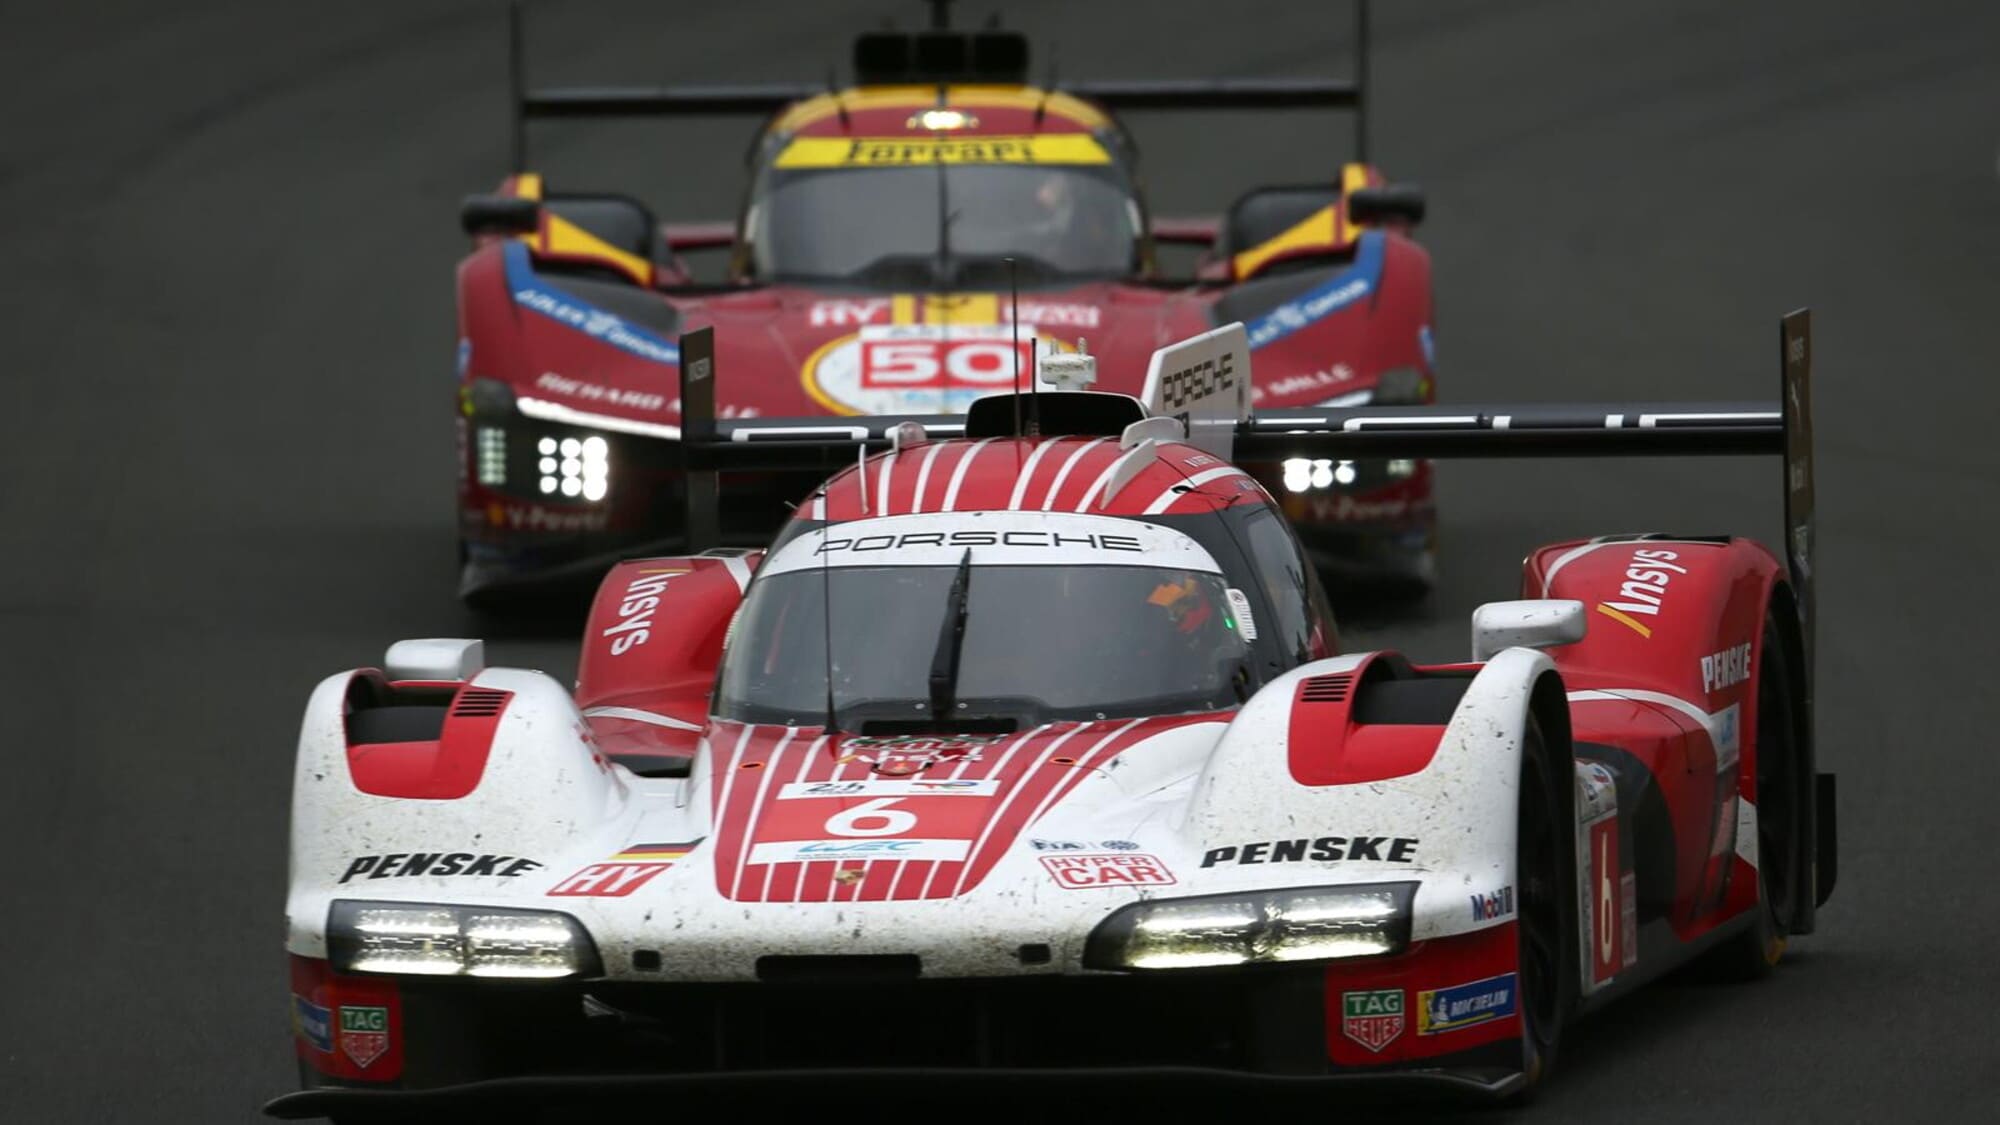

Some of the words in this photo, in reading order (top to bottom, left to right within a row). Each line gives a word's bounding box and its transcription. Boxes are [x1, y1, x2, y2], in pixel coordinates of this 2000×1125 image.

[846, 137, 1041, 165] Ferrari
[870, 344, 1024, 385] 50
[1162, 353, 1233, 411] PORSCHE
[813, 531, 1143, 556] PORSCHE
[1597, 549, 1687, 639] Ansys
[603, 568, 692, 656] Ansys
[1701, 642, 1752, 694] PENSKE
[824, 797, 918, 837] 6
[1049, 856, 1150, 868] HYPER
[1200, 837, 1421, 868] PENSKE
[338, 853, 545, 884] PENSKE
[563, 866, 655, 893] HY
[1060, 866, 1166, 885] CAR
[1600, 831, 1614, 964] 6
[1351, 995, 1398, 1013] TAG
[1450, 989, 1509, 1017] MICHELIN
[343, 1011, 382, 1029] TAG
[1349, 1018, 1400, 1046] HEUER
